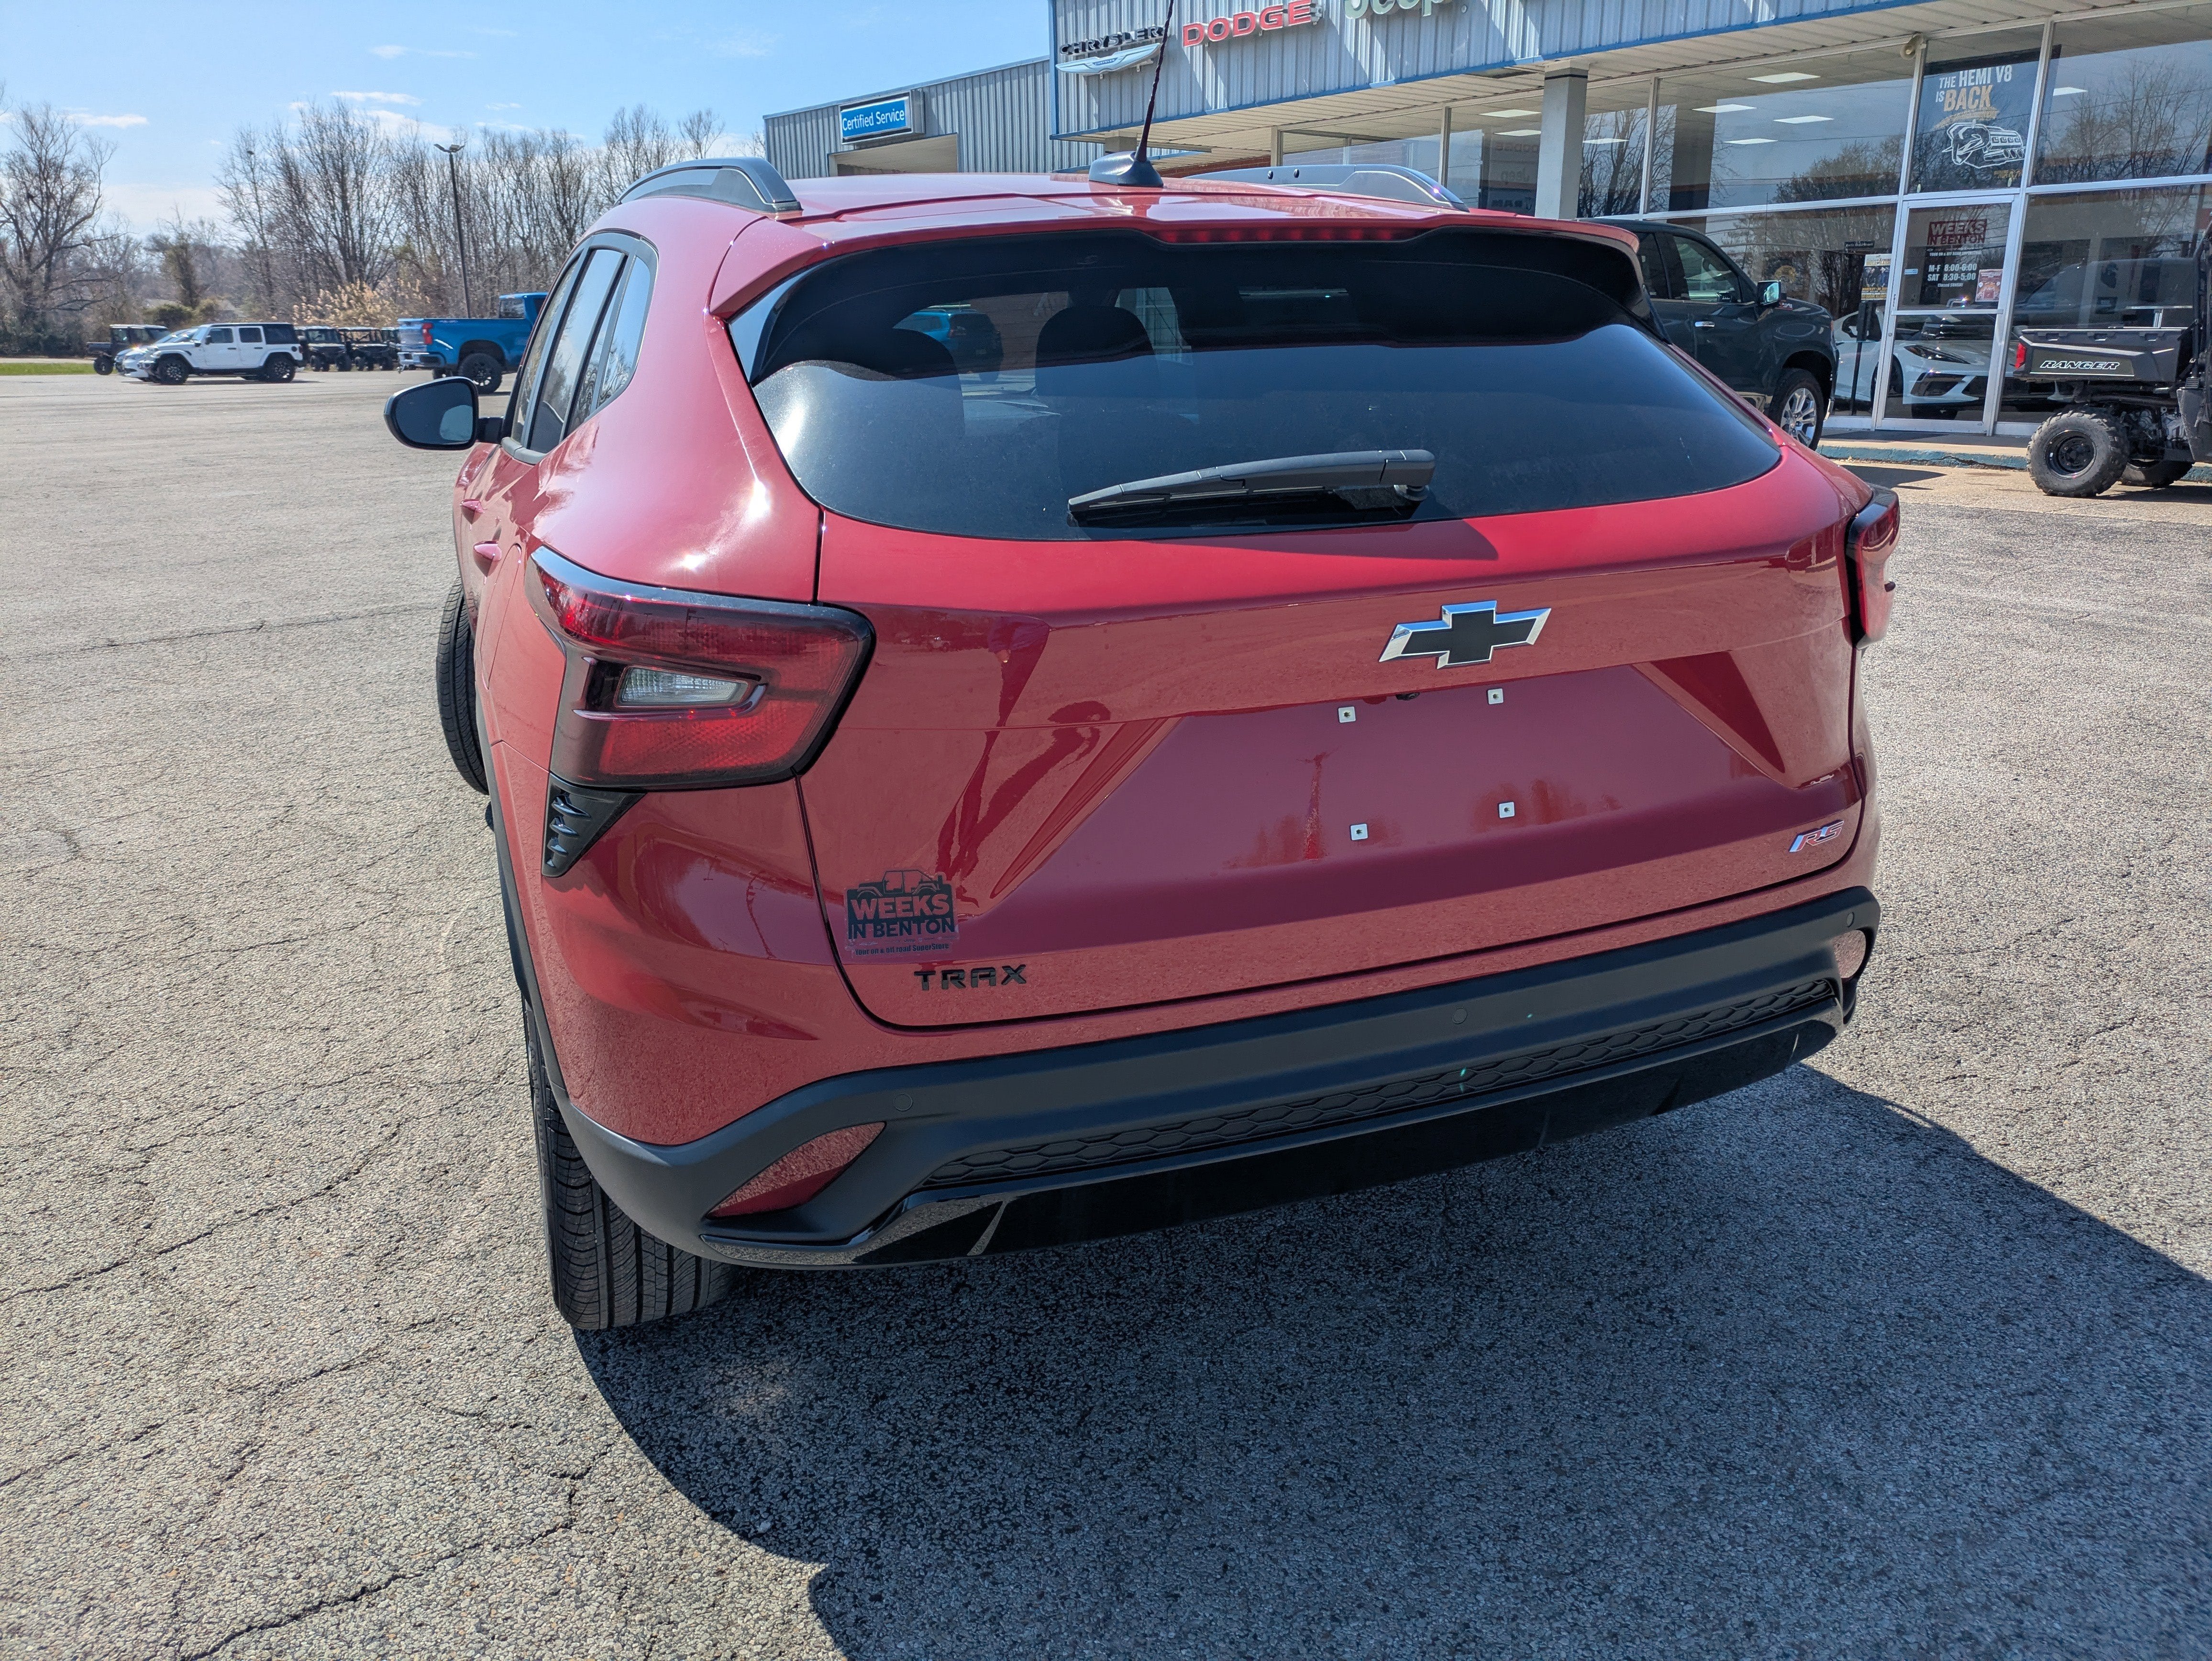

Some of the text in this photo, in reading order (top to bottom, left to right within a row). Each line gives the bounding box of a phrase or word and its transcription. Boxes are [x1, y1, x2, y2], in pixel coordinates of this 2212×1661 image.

[1183, 0, 1312, 47] DODGE
[1060, 24, 1164, 55] CHRYSLER
[1939, 65, 2012, 89] THE HEMI V8
[1935, 84, 1994, 111] IS BACK
[842, 108, 905, 131] Certified Service
[1931, 221, 1985, 235] WEEKS
[1940, 234, 1985, 245] BENTON
[1928, 264, 1978, 272] M-F 8:00-6:00
[1943, 273, 1976, 281] 8:30-5:00
[2040, 360, 2120, 370] RANGER
[1789, 810, 1845, 853] RS
[851, 894, 950, 920] WEEKS
[848, 918, 955, 940] IN BENTON
[914, 964, 1027, 991] TRAX
